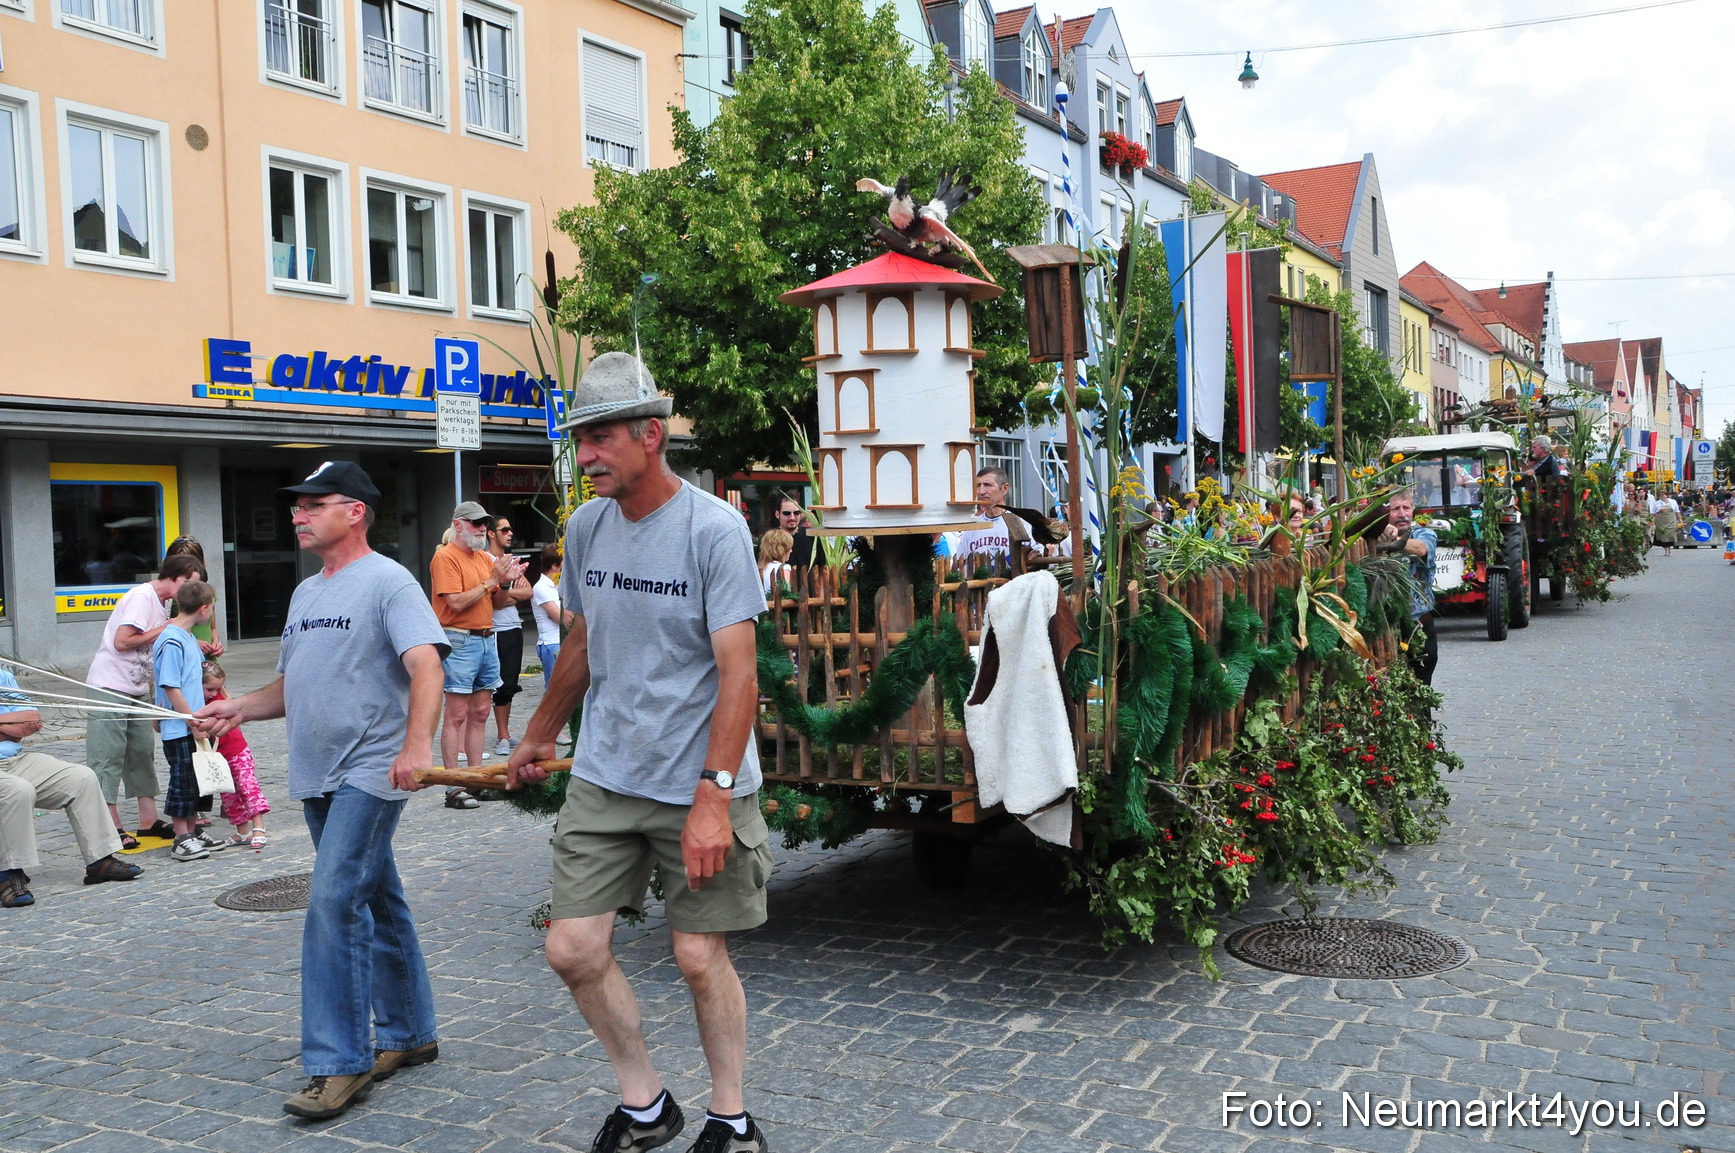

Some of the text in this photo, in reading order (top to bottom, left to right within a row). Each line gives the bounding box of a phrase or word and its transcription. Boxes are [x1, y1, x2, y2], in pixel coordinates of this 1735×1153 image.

[203, 338, 253, 384] E
[266, 350, 411, 395] aktiv
[445, 345, 470, 386] P
[209, 387, 251, 398] EDEKA
[440, 405, 478, 416] Parkschein
[444, 416, 475, 426] werktags
[493, 470, 530, 490] Super
[970, 537, 1009, 551] CALIFOR
[585, 569, 689, 598] GZV Neumarkt
